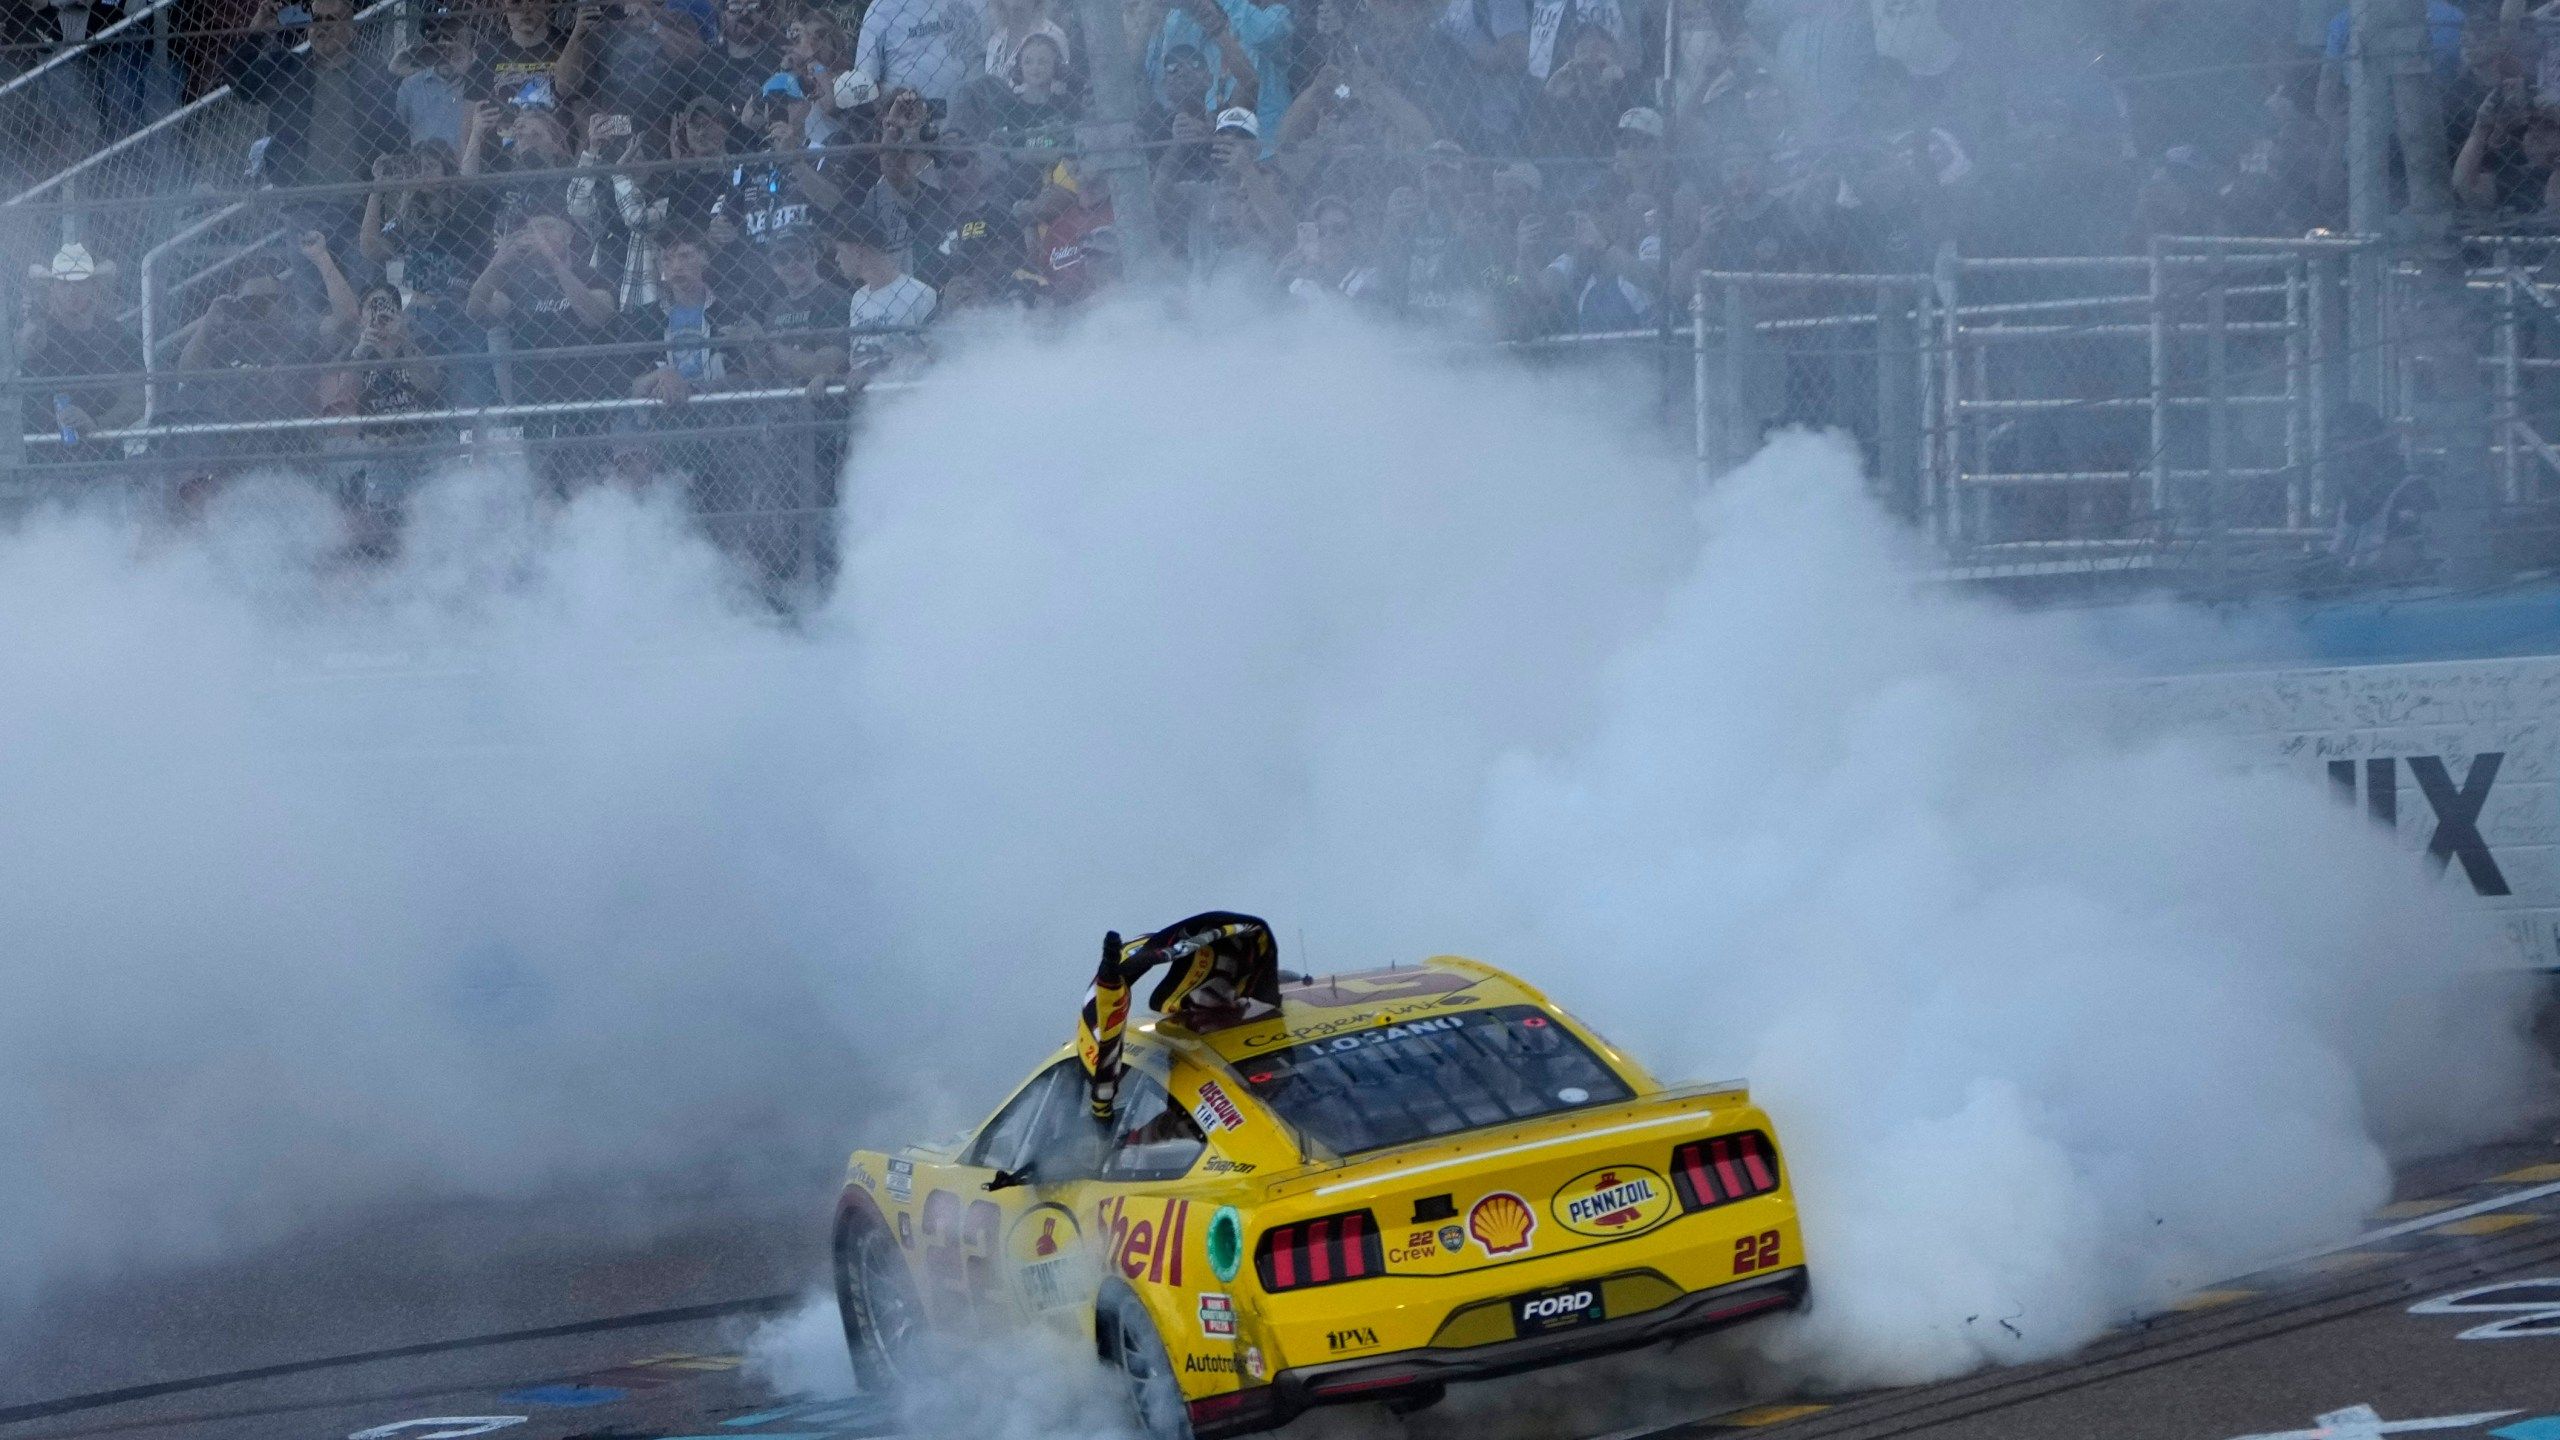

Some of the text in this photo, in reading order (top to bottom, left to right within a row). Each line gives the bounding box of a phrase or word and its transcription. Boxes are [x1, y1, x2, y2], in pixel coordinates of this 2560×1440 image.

[1196, 1104, 1217, 1131] TIRE
[1198, 1081, 1245, 1132] DISCOUNT
[1203, 1155, 1257, 1175] Snap-on
[1569, 1179, 1655, 1223] PENNZOIL
[1098, 1195, 1189, 1287] Shell
[1408, 1230, 1433, 1247] 22
[1733, 1229, 1781, 1275] 22
[1389, 1246, 1436, 1264] Crew
[1523, 1291, 1593, 1320] FORD
